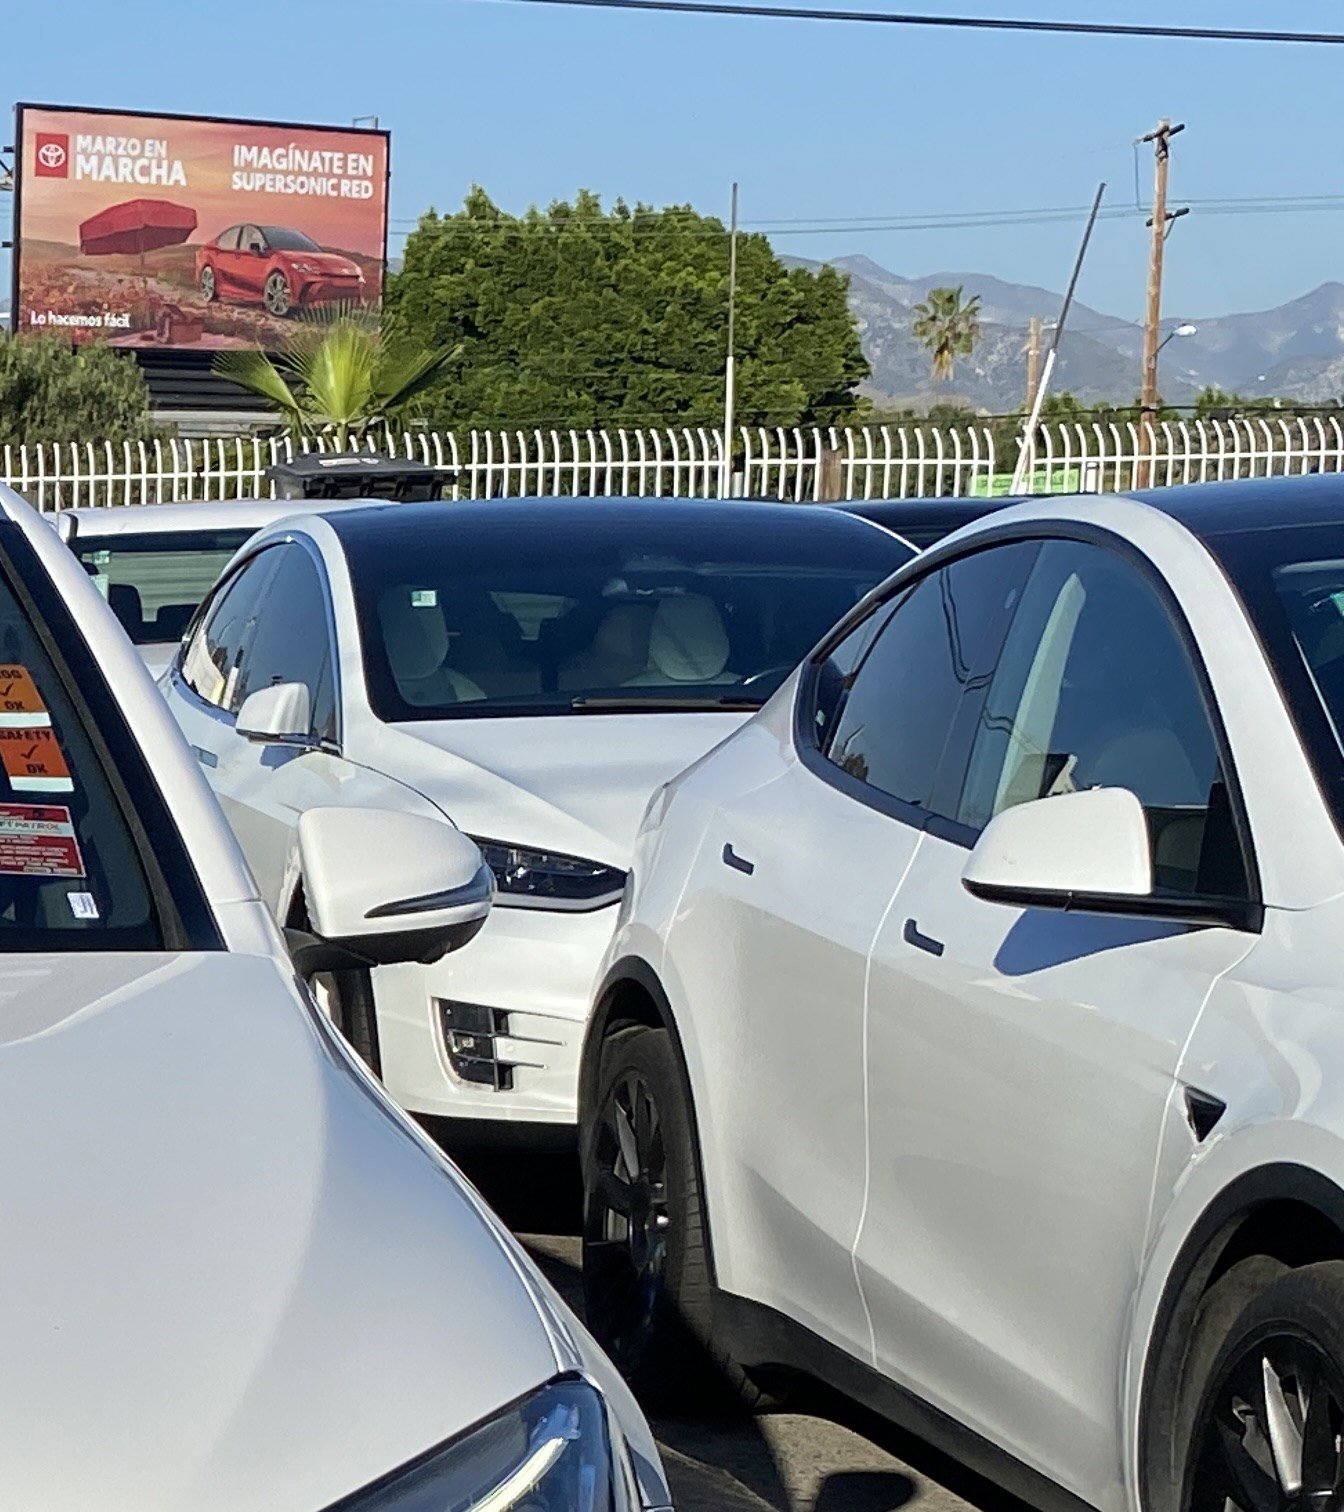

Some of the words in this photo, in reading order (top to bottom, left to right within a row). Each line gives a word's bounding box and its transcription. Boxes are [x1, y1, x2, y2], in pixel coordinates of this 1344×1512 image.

[75, 134, 141, 155] MARZO
[144, 139, 168, 159] EN
[74, 155, 187, 187] MARCHA
[233, 143, 344, 175] IMAGÍNATE
[347, 154, 374, 177] EN
[232, 172, 338, 198] SUPERSONIC
[340, 177, 374, 199] RED
[30, 310, 46, 326] Lo
[47, 311, 101, 328] hacemos
[103, 311, 131, 328] fácil
[4, 700, 25, 711] OK
[26, 763, 49, 774] OK
